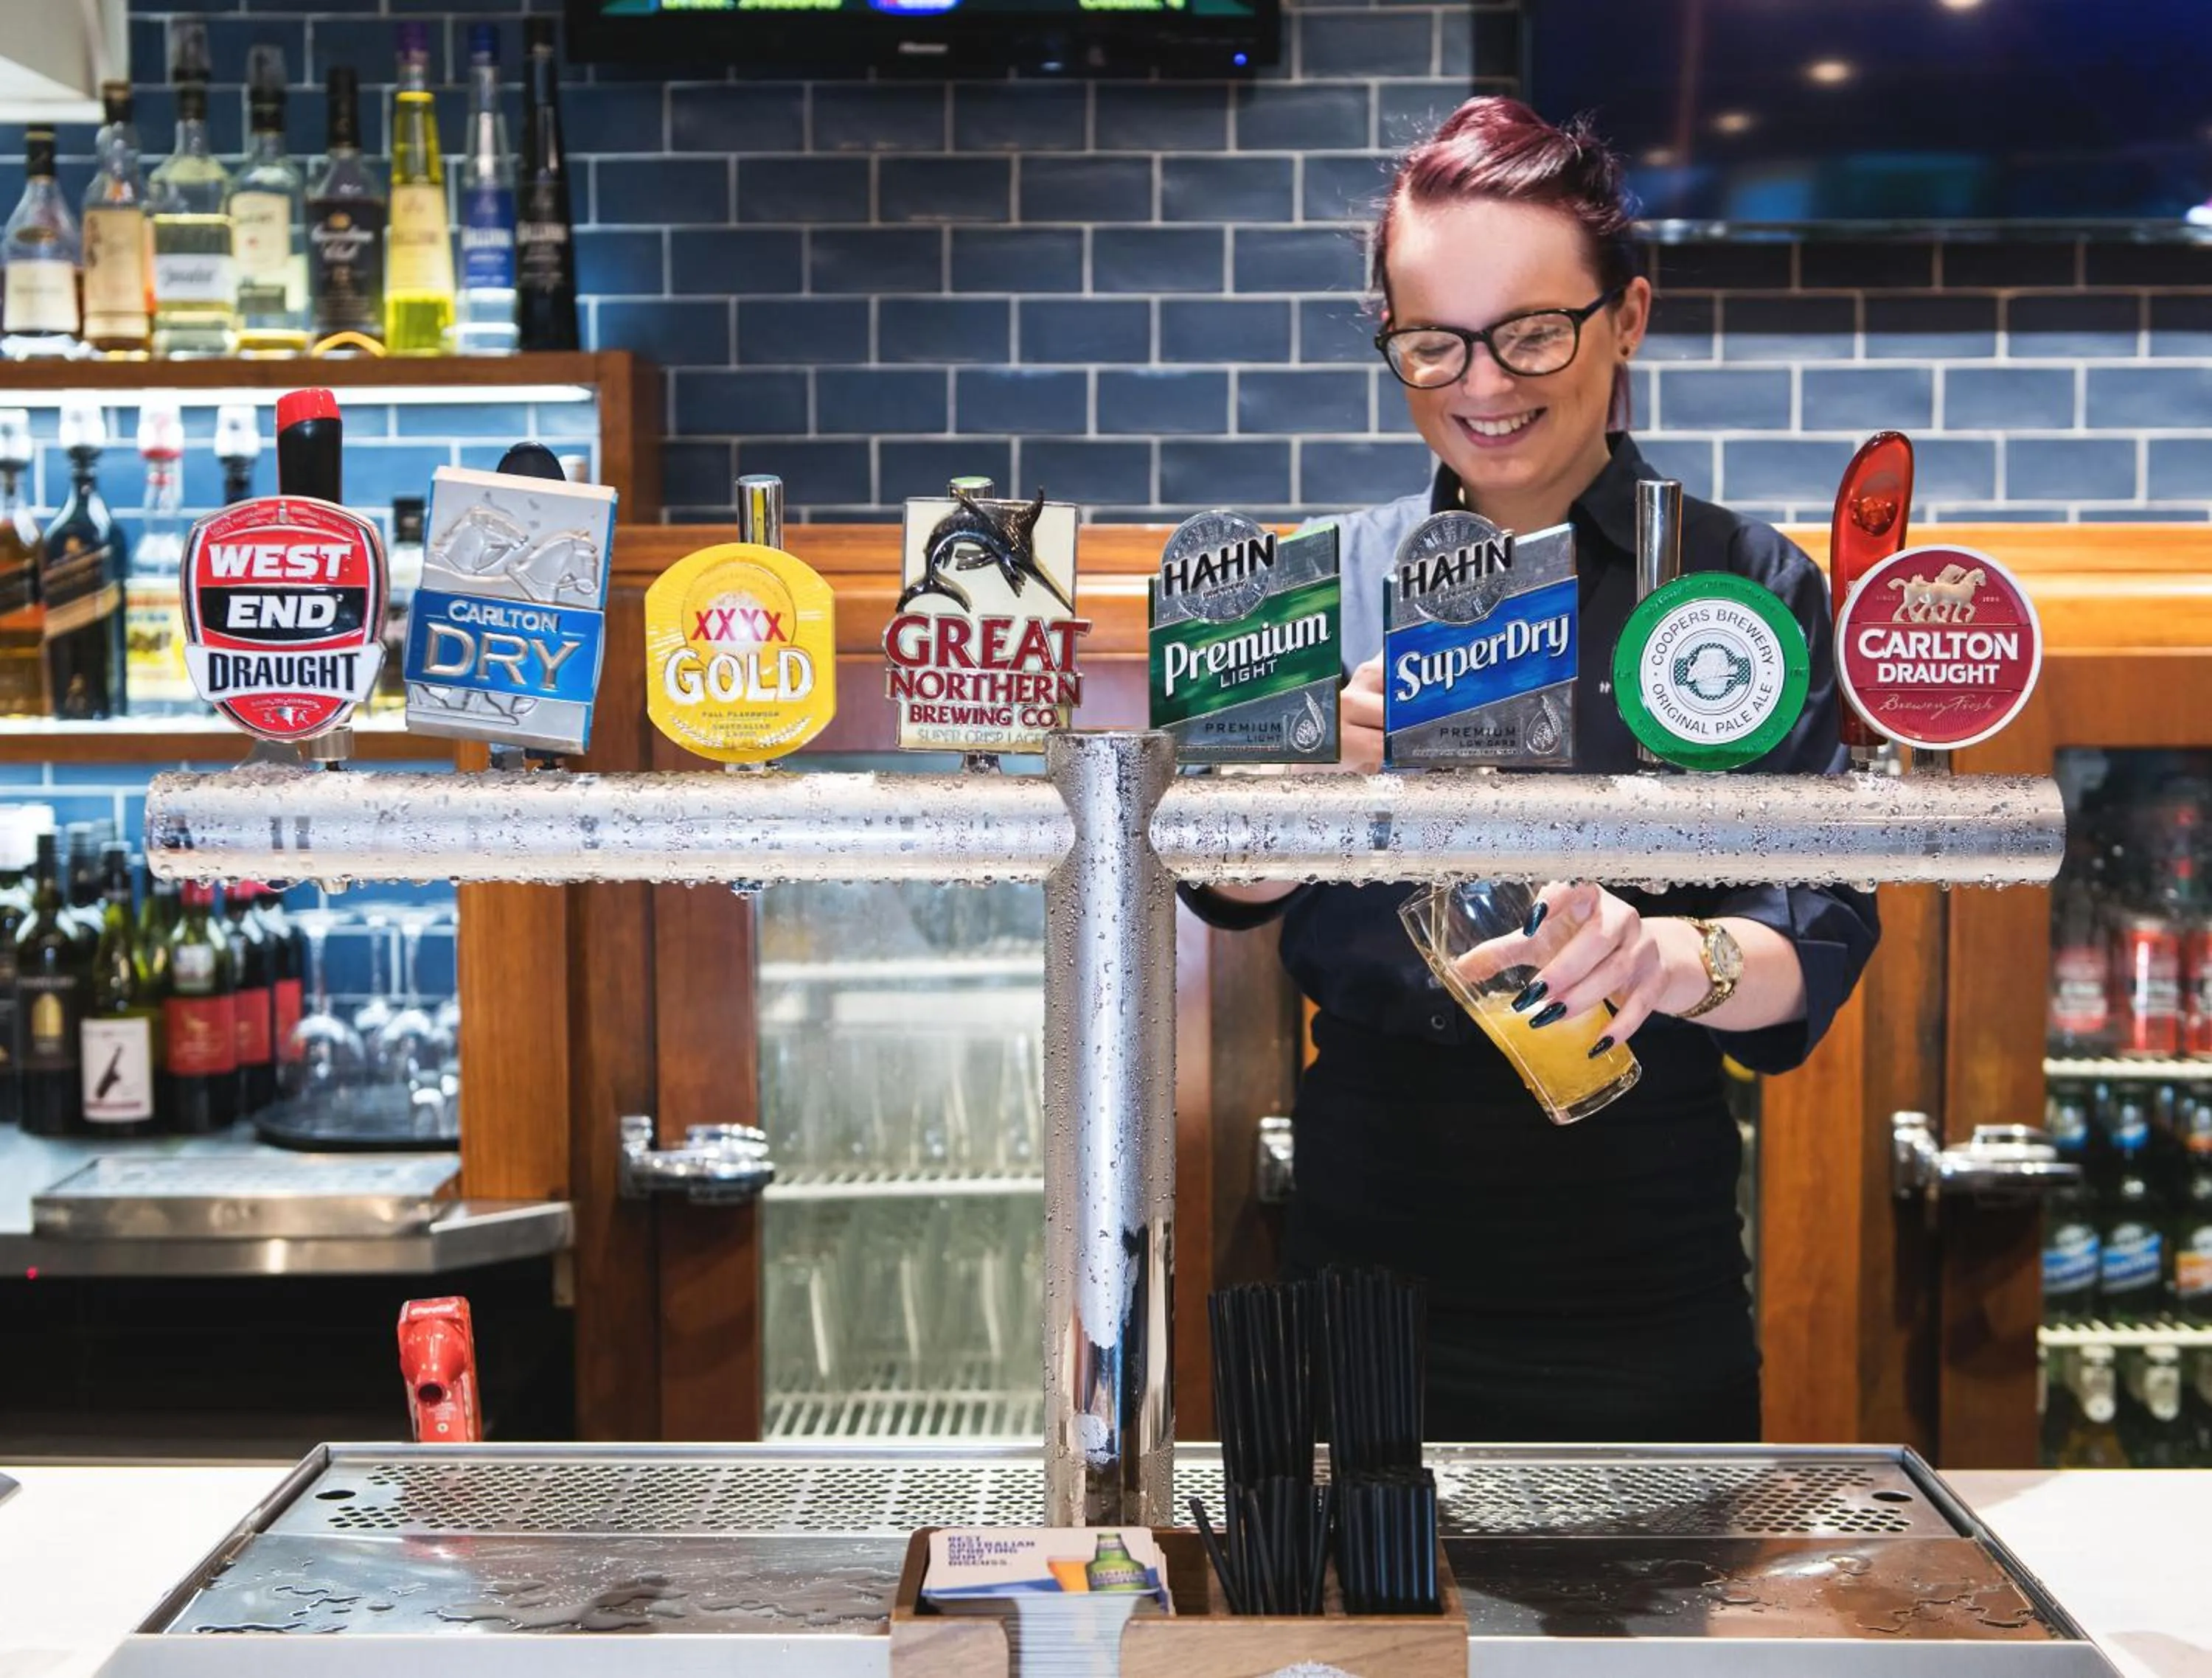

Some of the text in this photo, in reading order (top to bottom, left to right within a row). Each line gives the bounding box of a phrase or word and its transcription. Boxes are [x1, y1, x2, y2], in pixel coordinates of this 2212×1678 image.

[208, 543, 352, 578] WEST
[1164, 533, 1276, 597] HAHN
[1402, 535, 1513, 599] HAHN
[226, 594, 337, 630] END
[448, 599, 560, 633] CARLTON
[690, 608, 787, 642] XXXX
[884, 614, 1092, 673] GREAT
[1164, 612, 1330, 698] Premium
[1651, 608, 1775, 666] COOPERS BREWERY
[1857, 628, 2019, 661] CARLTON
[208, 652, 361, 693] DRAUGHT
[422, 622, 582, 692] DRY
[1220, 658, 1278, 689] LIGHT
[1396, 613, 1571, 702] SuperDry
[1877, 663, 2000, 684] DRAUGHT
[664, 646, 816, 706] GOLD
[888, 669, 1082, 706] NORTHERN
[909, 704, 1062, 728] BREWING CO.
[1652, 682, 1773, 736] ORIGINAL PALE ALE
[1205, 723, 1281, 734] PREMIUM
[1246, 734, 1281, 743] LIGHT
[1440, 727, 1516, 737] PREMIUM
